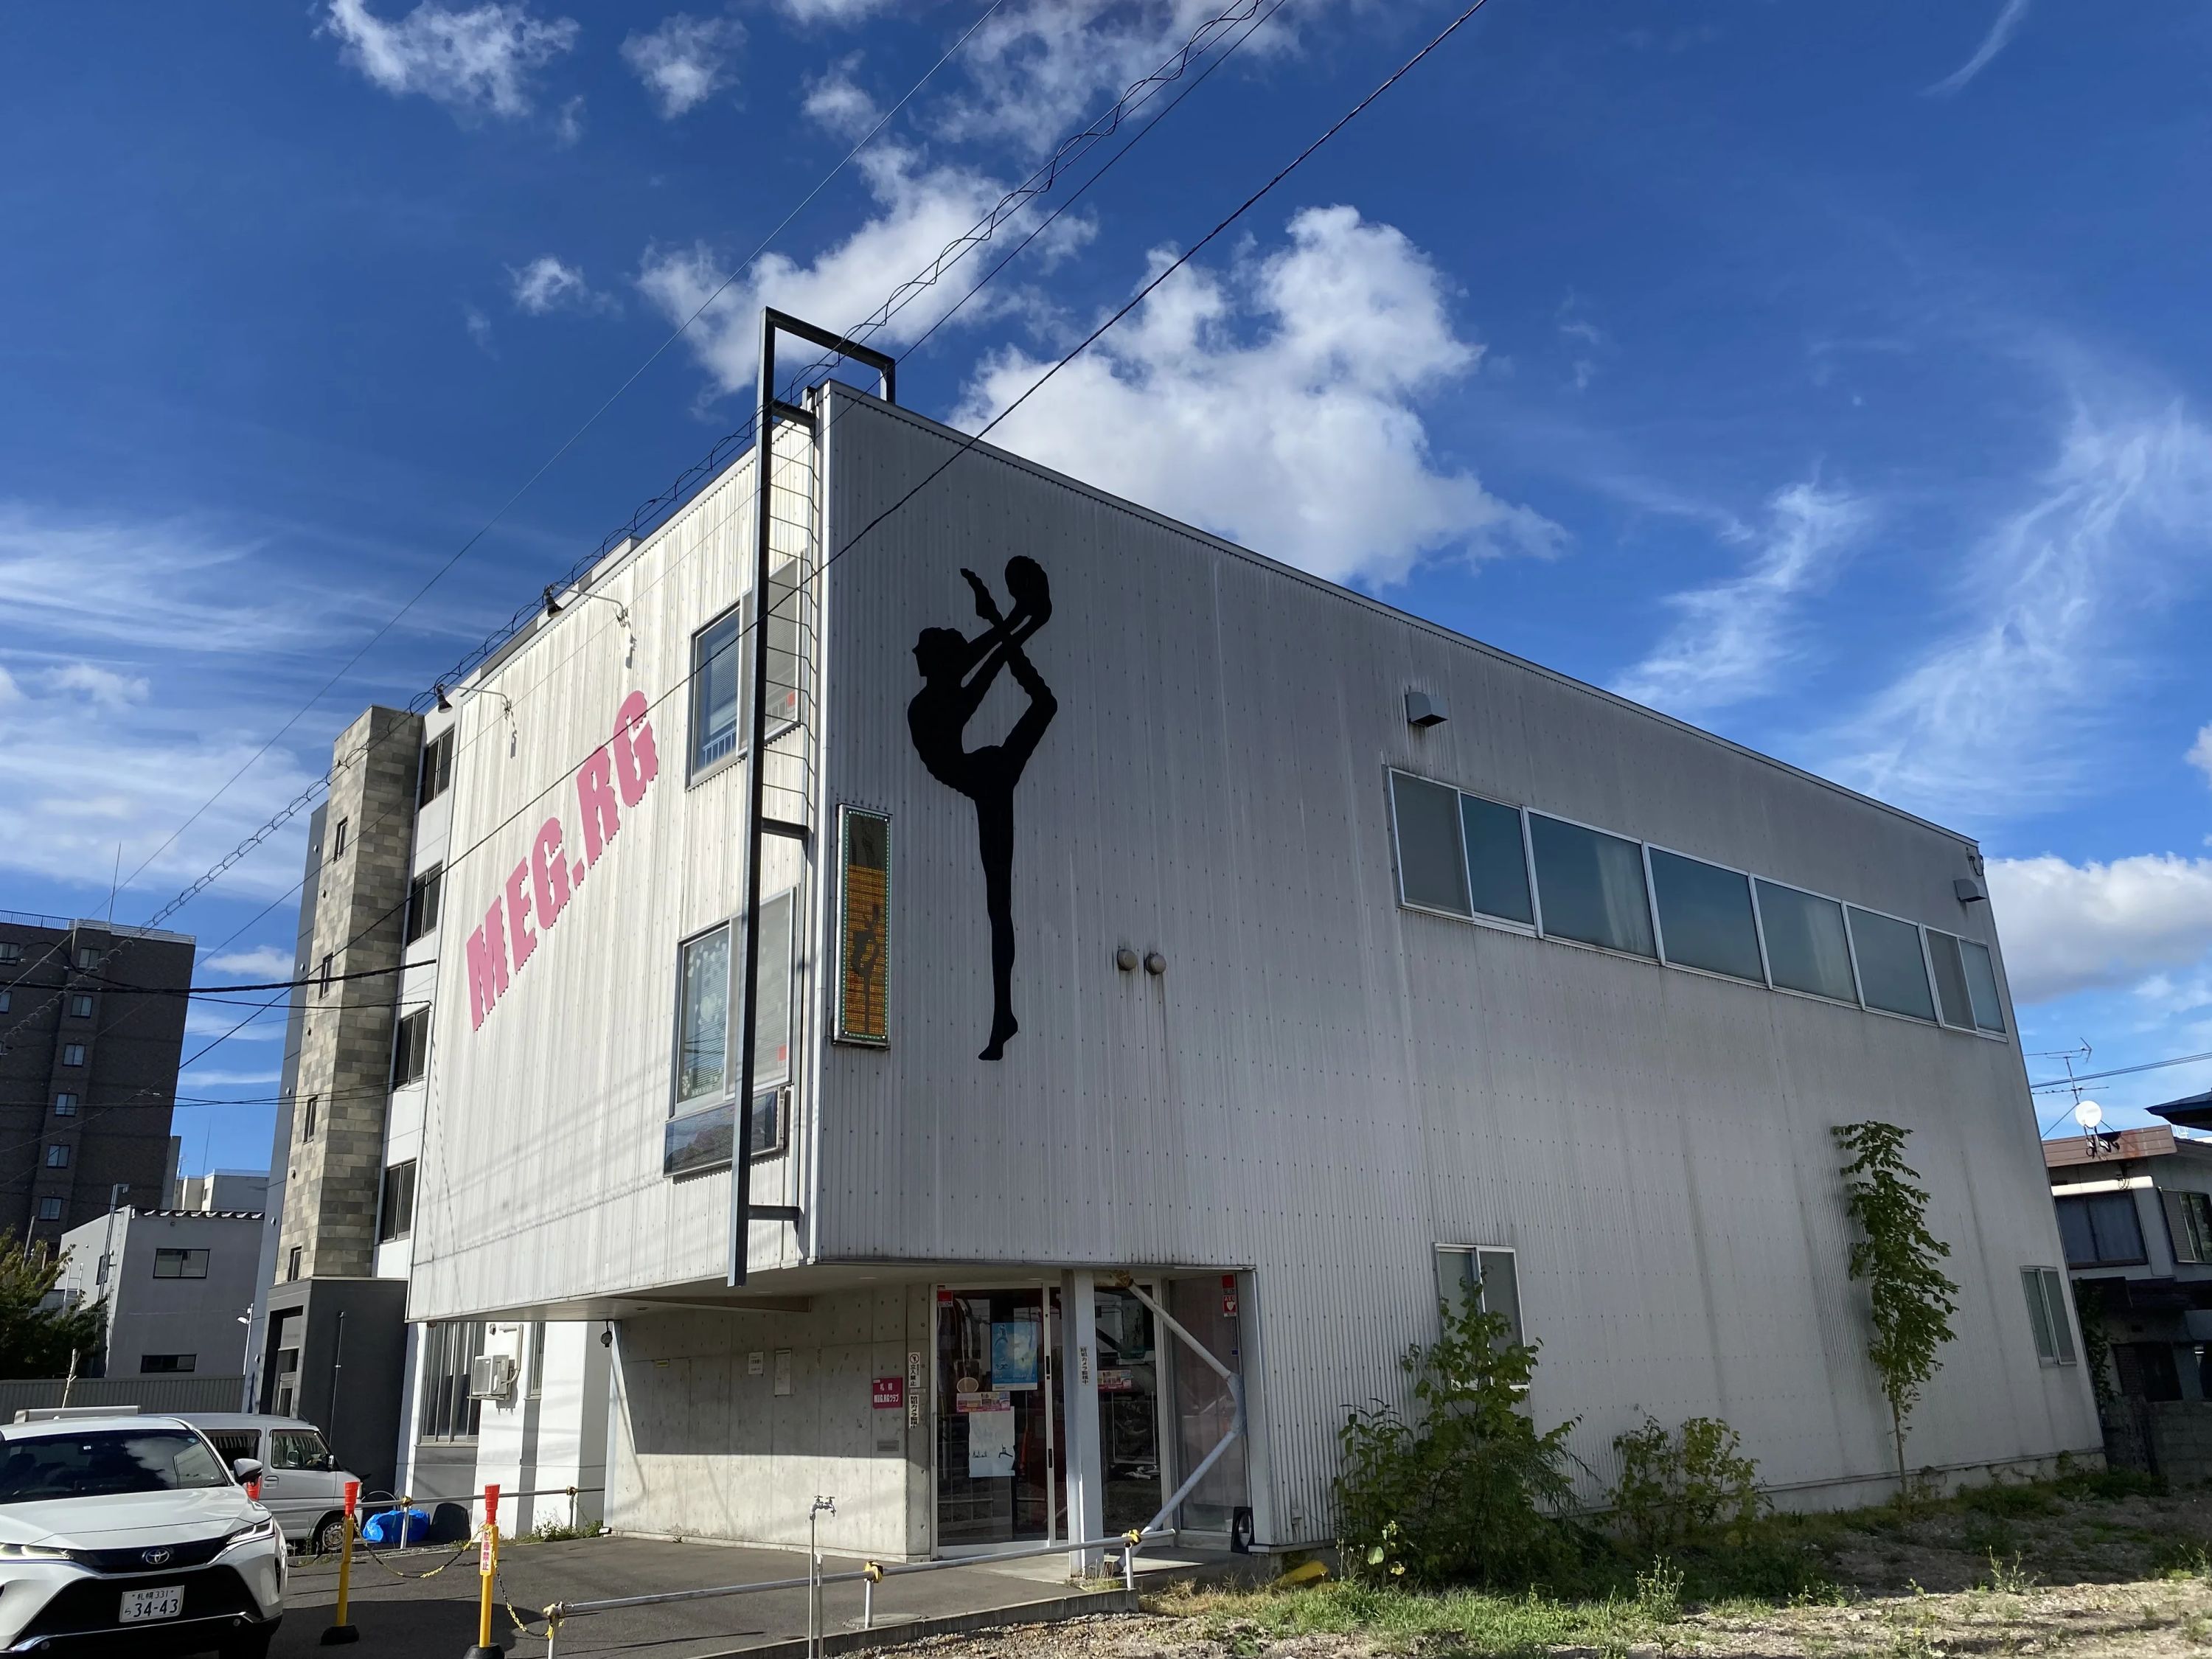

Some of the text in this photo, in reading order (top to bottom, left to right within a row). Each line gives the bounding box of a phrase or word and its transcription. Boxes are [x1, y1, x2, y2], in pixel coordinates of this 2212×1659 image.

[466, 690, 658, 1032] MEG.RG
[482, 1531, 490, 1571] 駐車禁止
[133, 1599, 178, 1617] 34-43
